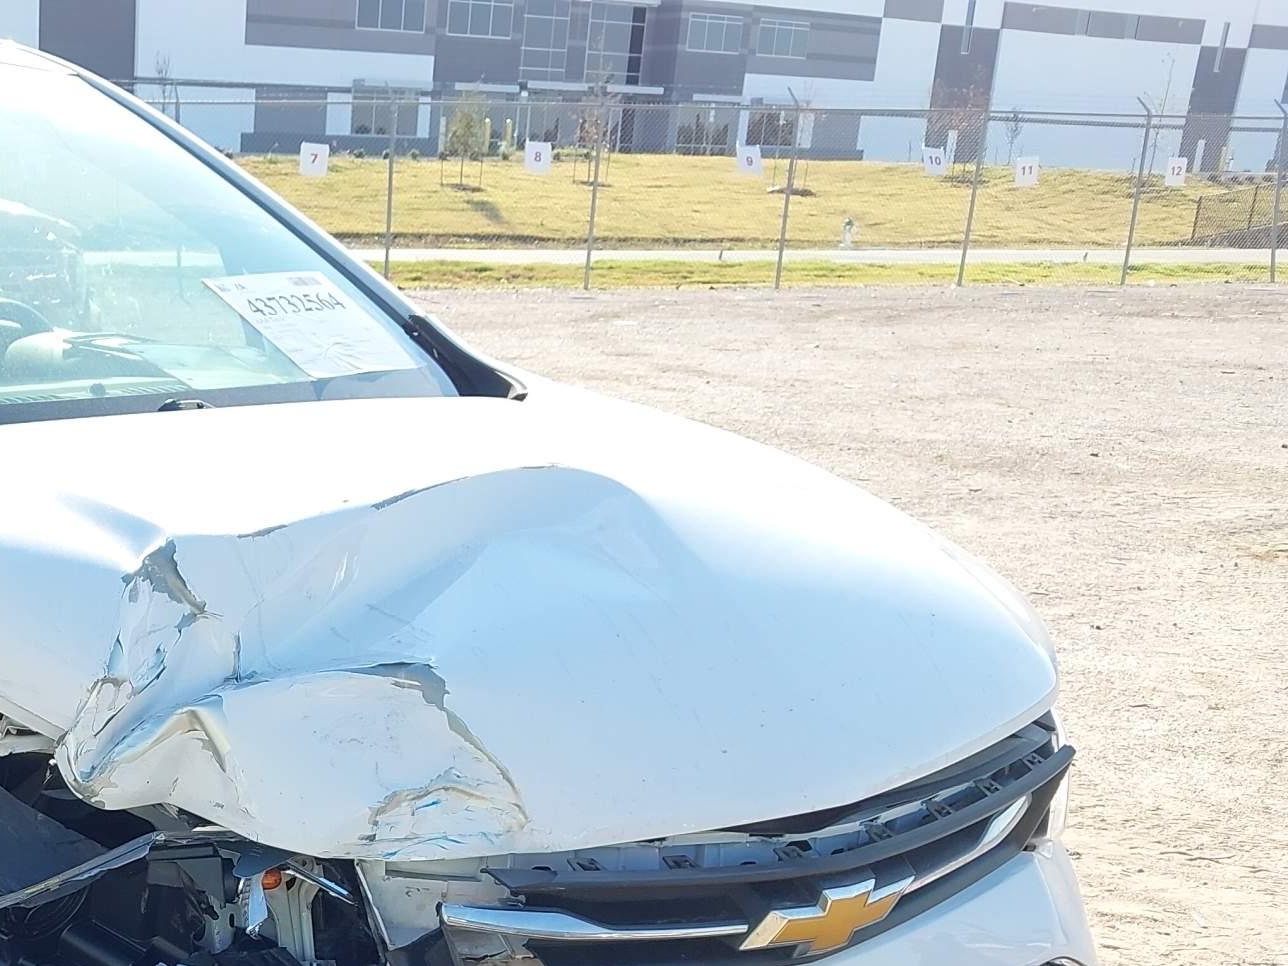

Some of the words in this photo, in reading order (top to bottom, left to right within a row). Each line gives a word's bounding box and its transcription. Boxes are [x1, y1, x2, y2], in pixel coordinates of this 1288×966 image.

[310, 153, 319, 164] 7
[534, 151, 542, 162] 8
[746, 155, 754, 166] 9
[928, 155, 942, 166] 10
[1021, 165, 1033, 176] 11
[1170, 165, 1183, 177] 12
[247, 292, 346, 316] 43732564
